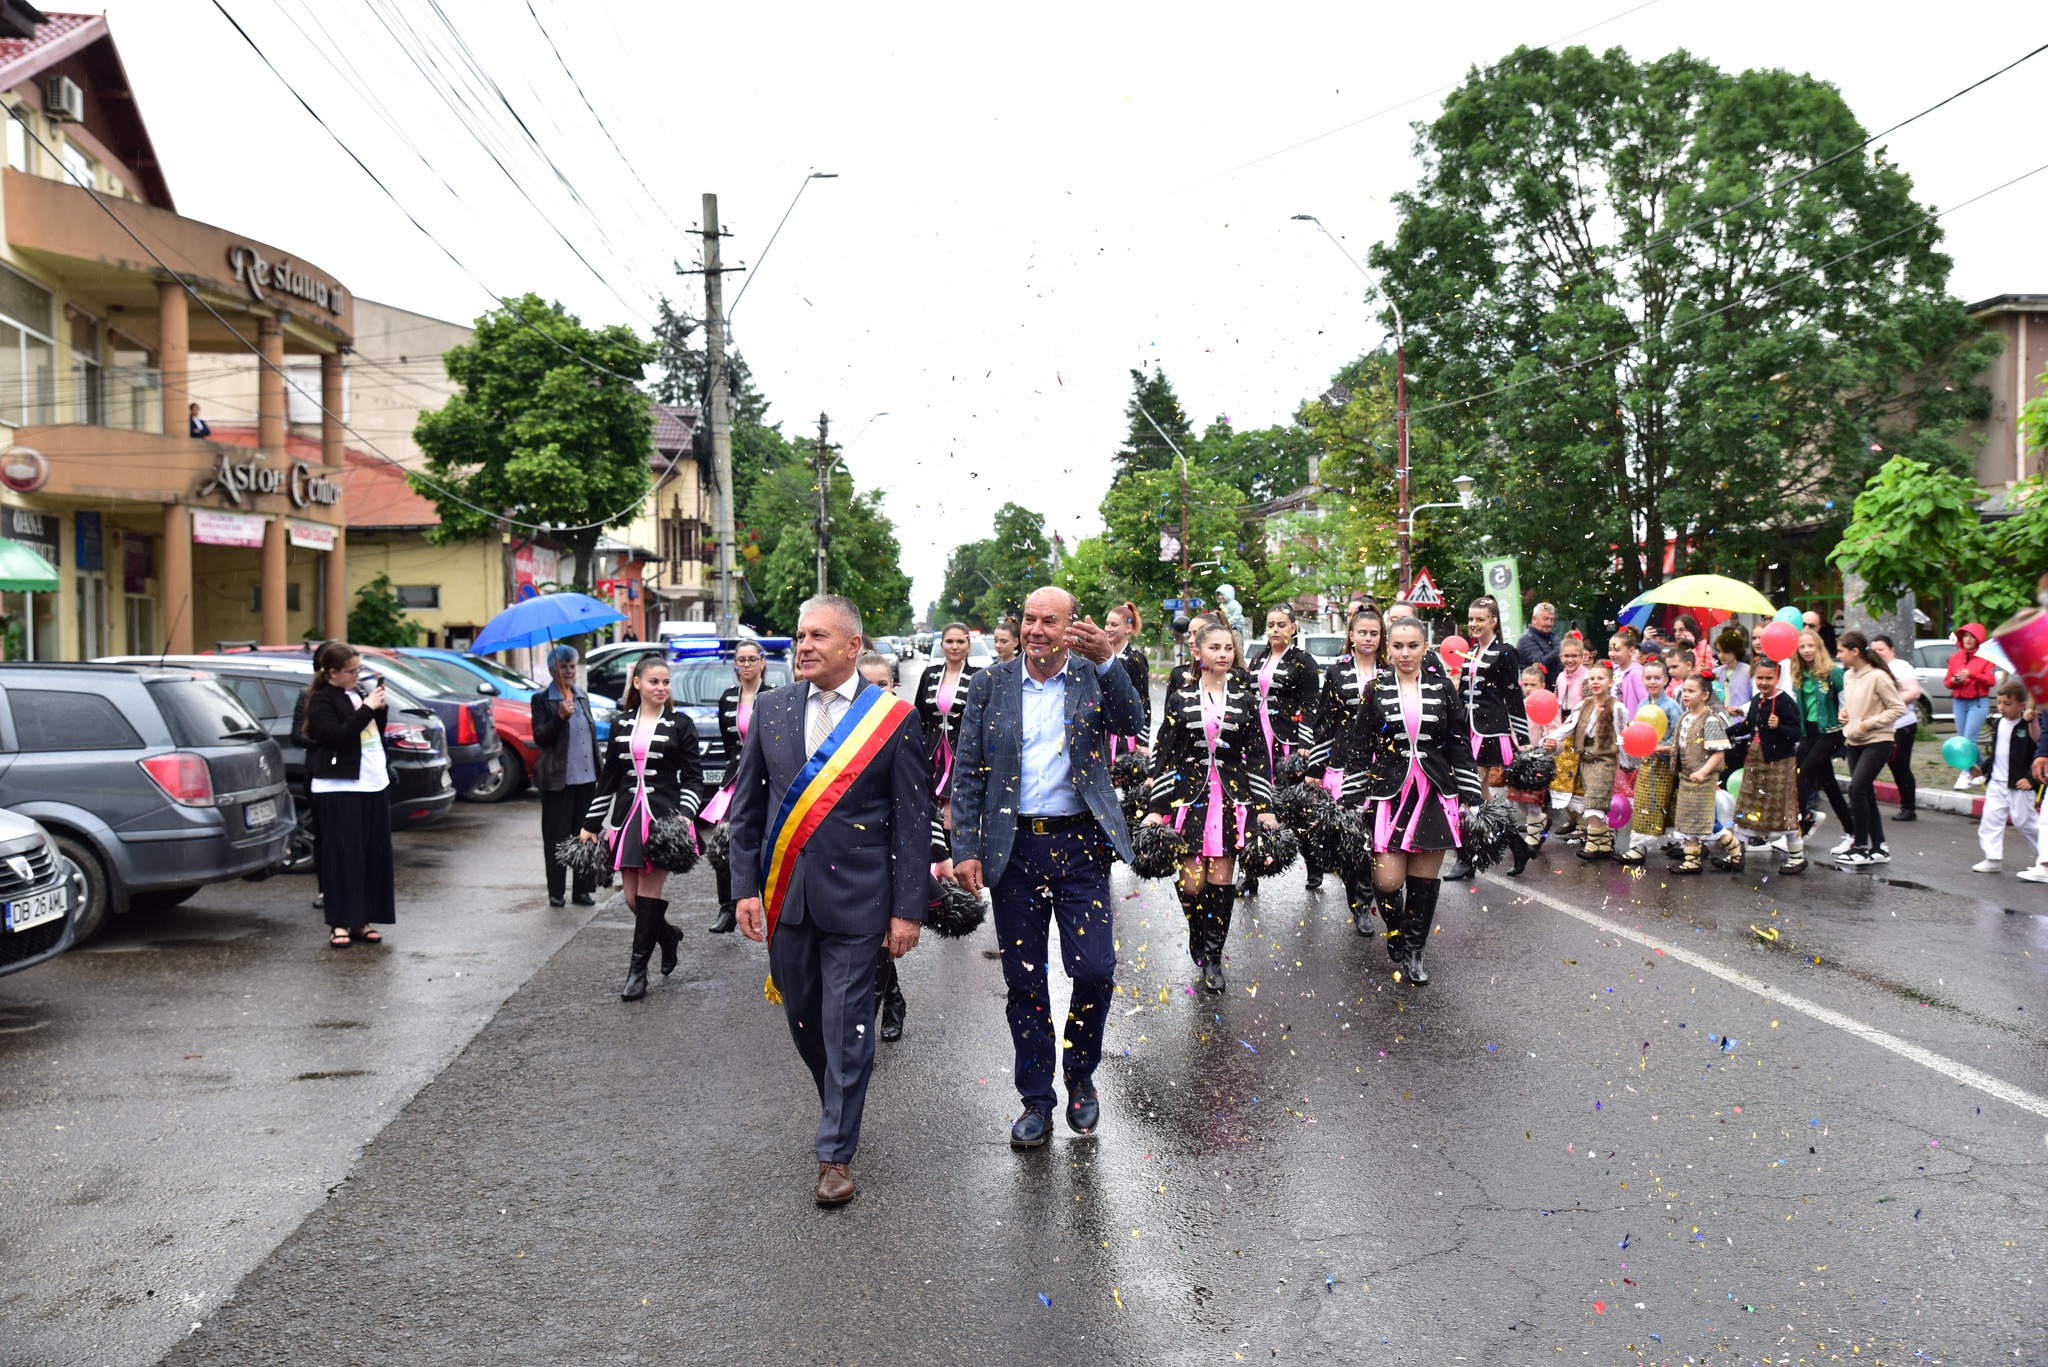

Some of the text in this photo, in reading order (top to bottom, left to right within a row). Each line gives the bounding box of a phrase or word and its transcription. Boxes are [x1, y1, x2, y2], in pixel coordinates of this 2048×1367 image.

[199, 454, 286, 503] Astor
[13, 901, 30, 924] DB
[35, 896, 47, 917] 26
